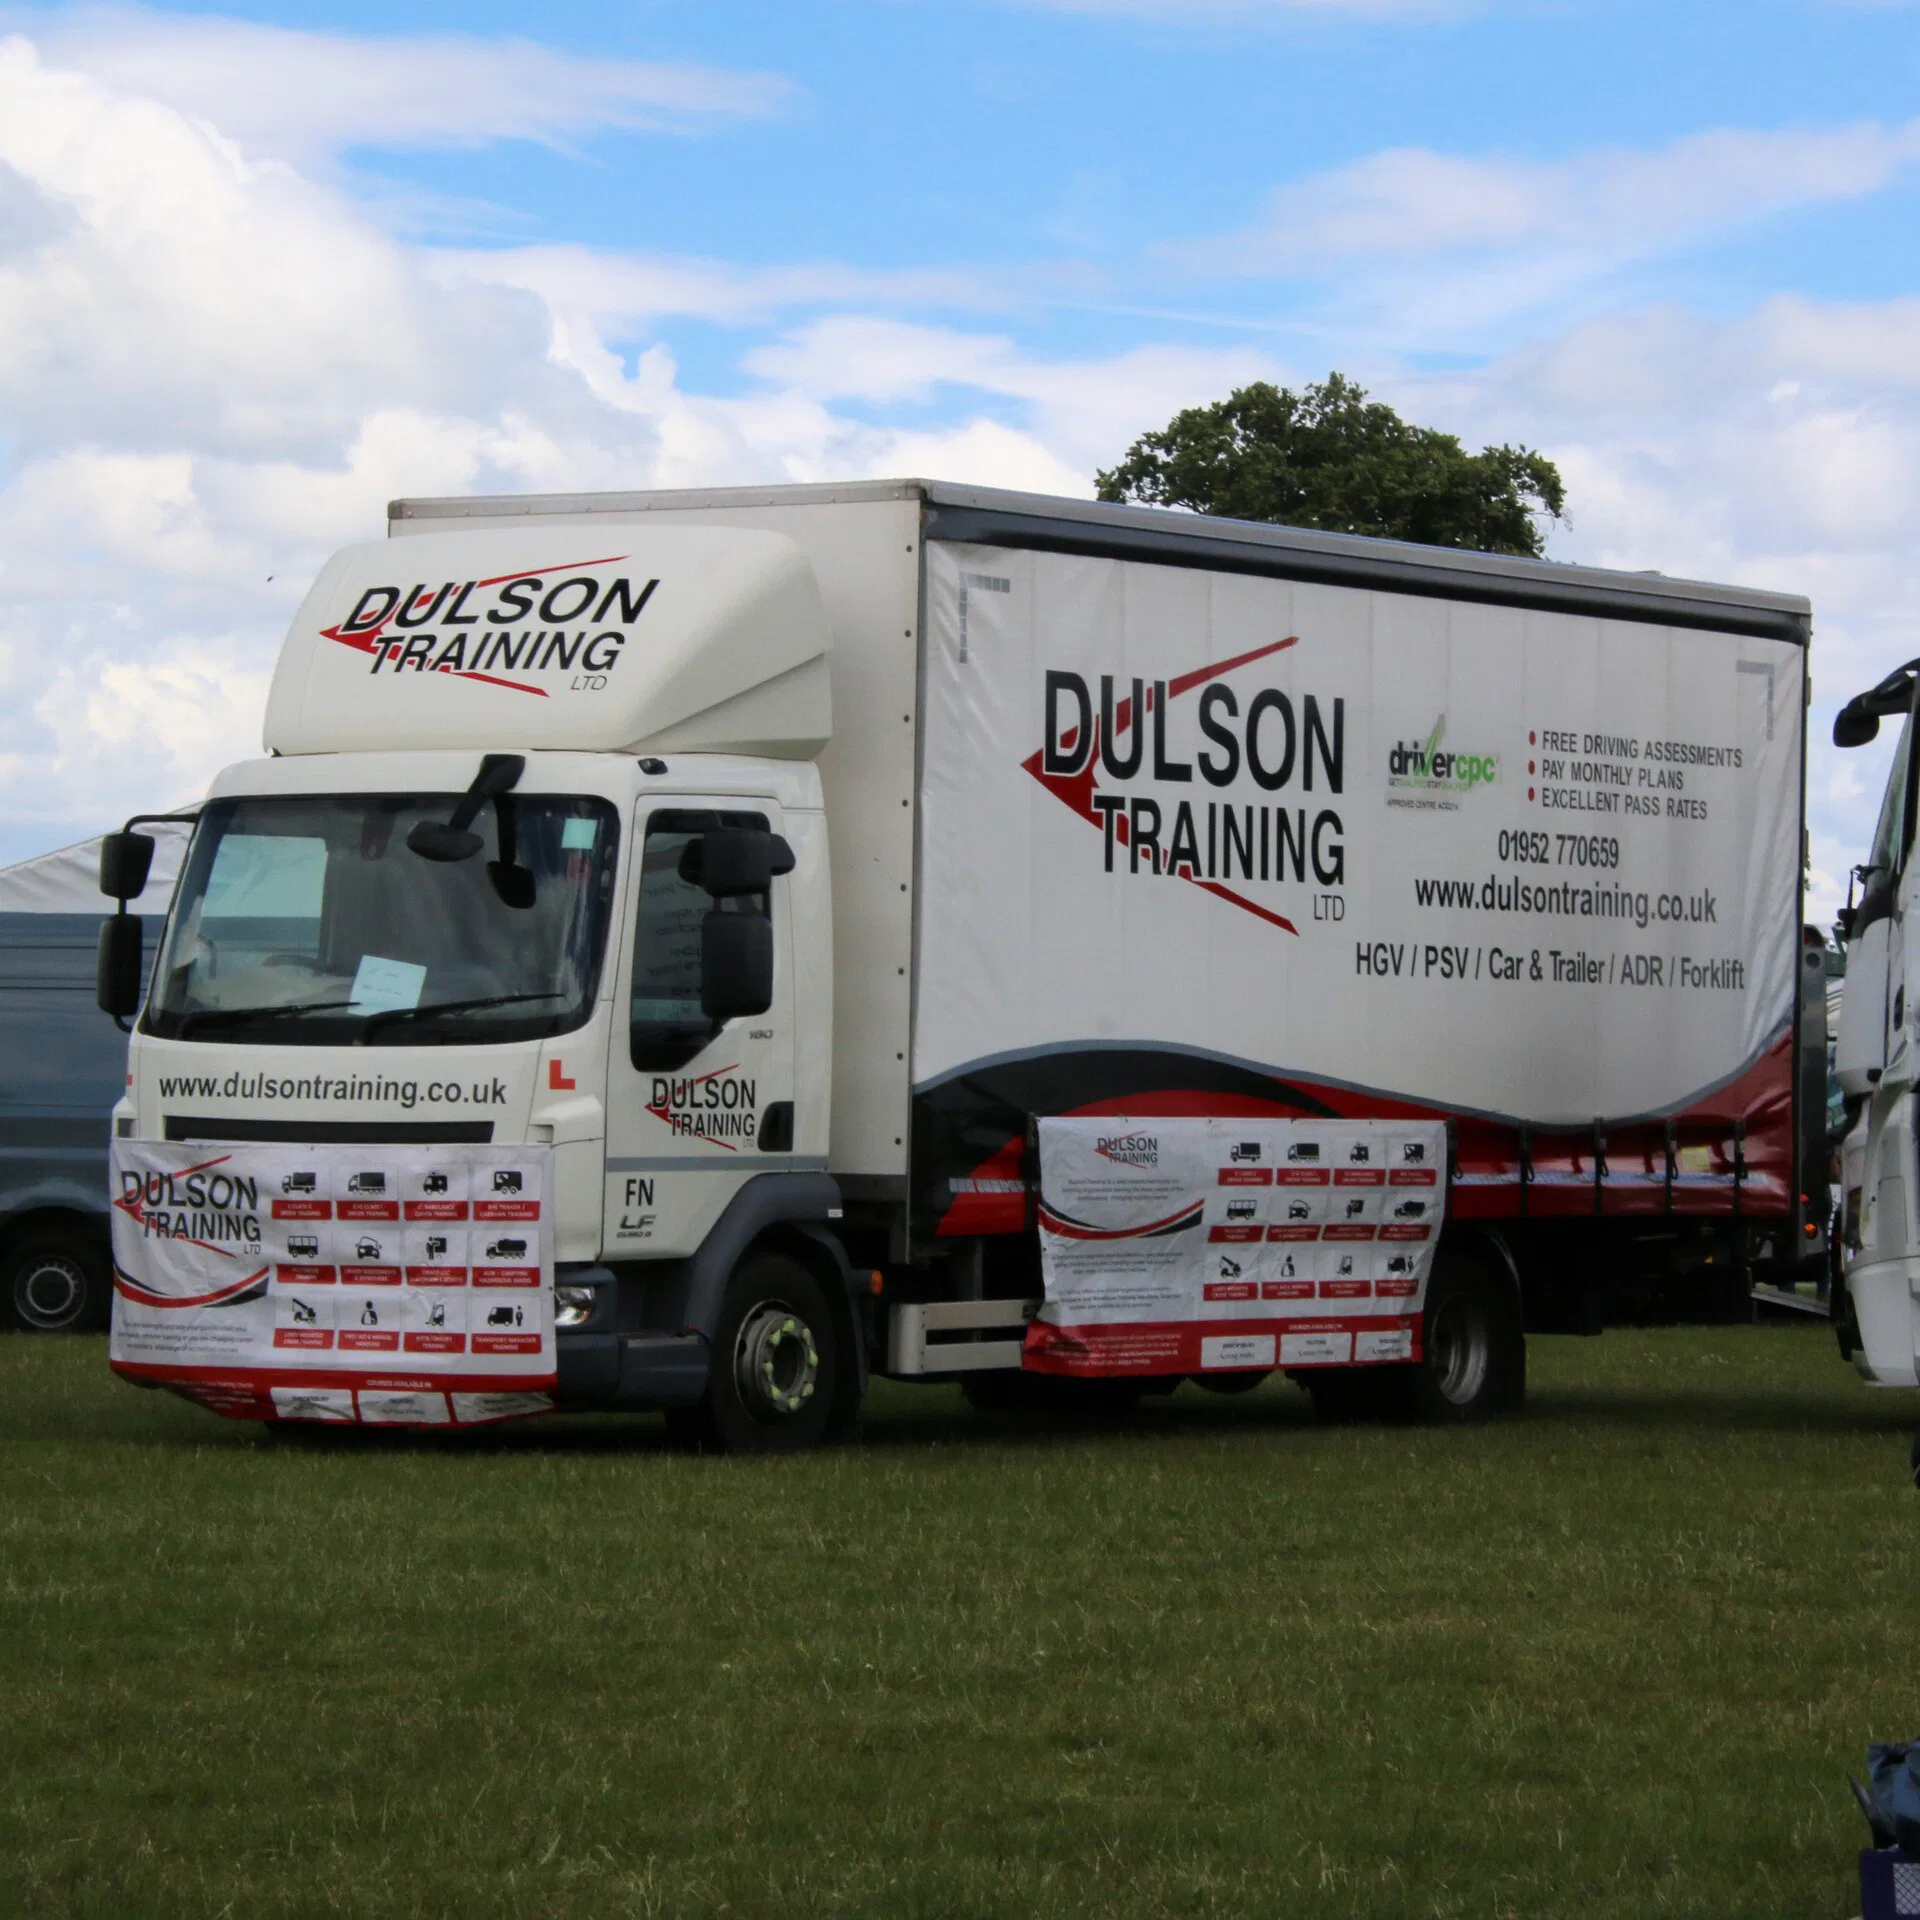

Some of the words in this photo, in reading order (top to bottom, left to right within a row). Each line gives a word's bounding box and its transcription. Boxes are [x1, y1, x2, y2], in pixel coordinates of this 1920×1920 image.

[341, 577, 660, 633] DULSON
[370, 631, 625, 674] TRAINING
[570, 675, 607, 691] LTD
[1044, 669, 1345, 794] DULSON
[1542, 730, 1578, 753] FREE
[1583, 734, 1639, 759] DRIVING
[1644, 740, 1743, 768] ASSESSMENTS
[1542, 758, 1565, 780] PAY
[1571, 762, 1633, 787] MONTHLY
[1638, 768, 1684, 791] PLANS
[1542, 787, 1620, 814] EXCELLENT
[1624, 794, 1661, 817] PASS
[1666, 798, 1708, 820] RATES
[1093, 794, 1344, 886] TRAINING
[1498, 829, 1549, 864] 01952
[1555, 833, 1619, 869] 770659
[1313, 895, 1345, 922] LTD
[1415, 874, 1717, 929] www.dulsontraining.co.uk
[1356, 942, 1405, 976] HGV
[1410, 944, 1418, 977] /
[1424, 945, 1469, 979] PSV
[1474, 947, 1482, 981] /
[1488, 947, 1524, 981] Car
[1529, 949, 1544, 981] &
[1549, 950, 1605, 985] Trailer
[1608, 952, 1616, 986] /
[1620, 954, 1664, 987] ADR
[1668, 955, 1676, 988] /
[1681, 956, 1745, 990] Forklift
[159, 1072, 507, 1109] www.dulsontraining.co.uk
[549, 1059, 575, 1090] L
[652, 1077, 755, 1109] DULSON
[669, 1113, 755, 1137] TRAINING
[1097, 1136, 1158, 1152] DULSON
[1108, 1152, 1158, 1164] TRAINING
[121, 1170, 259, 1211] DULSON
[626, 1179, 654, 1207] FN
[141, 1211, 261, 1242] TRAINING
[243, 1244, 260, 1256] LTD
